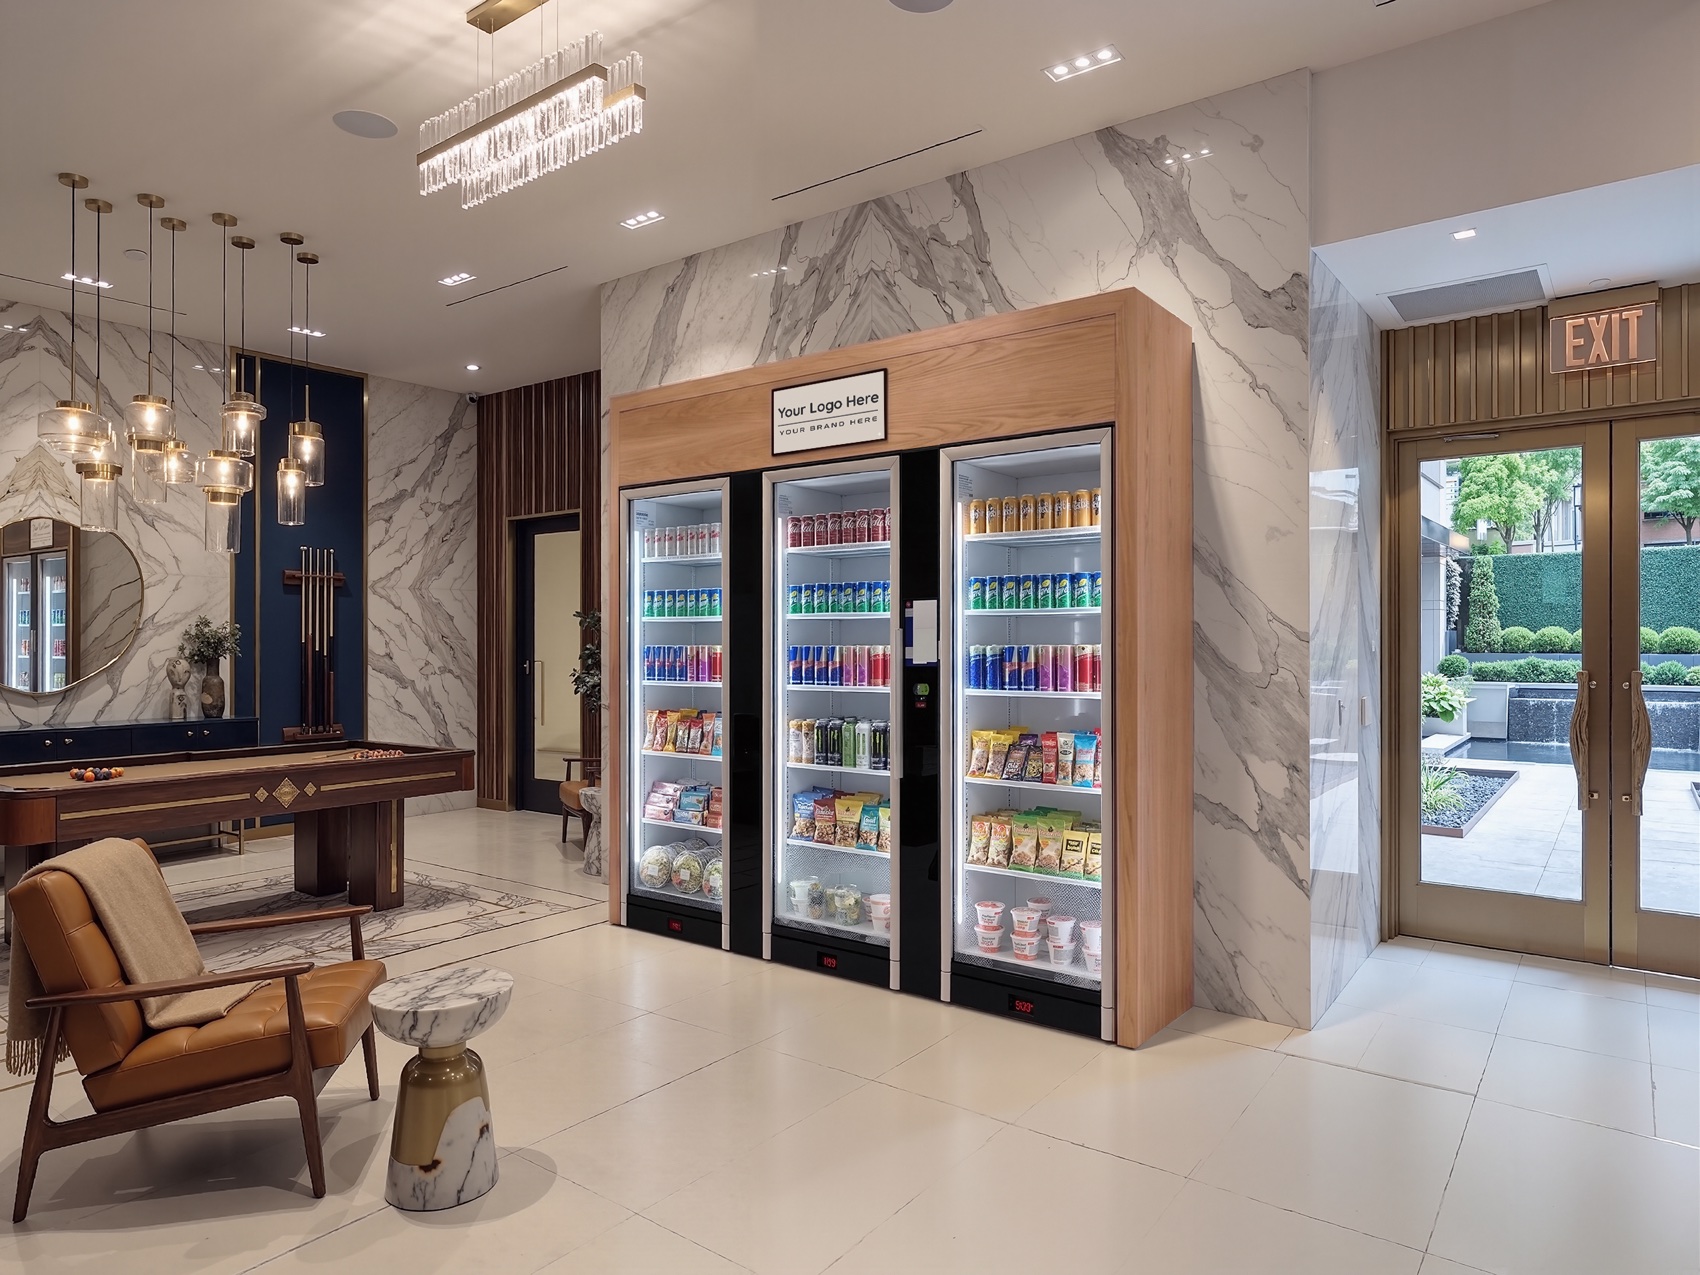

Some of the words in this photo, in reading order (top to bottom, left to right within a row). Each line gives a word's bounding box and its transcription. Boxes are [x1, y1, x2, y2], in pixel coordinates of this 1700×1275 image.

[1566, 309, 1643, 367] EXIT
[778, 406, 806, 418] Your
[809, 400, 842, 414] Logo
[846, 394, 879, 407] Here
[779, 427, 805, 436] YOUR
[809, 421, 845, 431] BRAND
[849, 416, 878, 425] HERE
